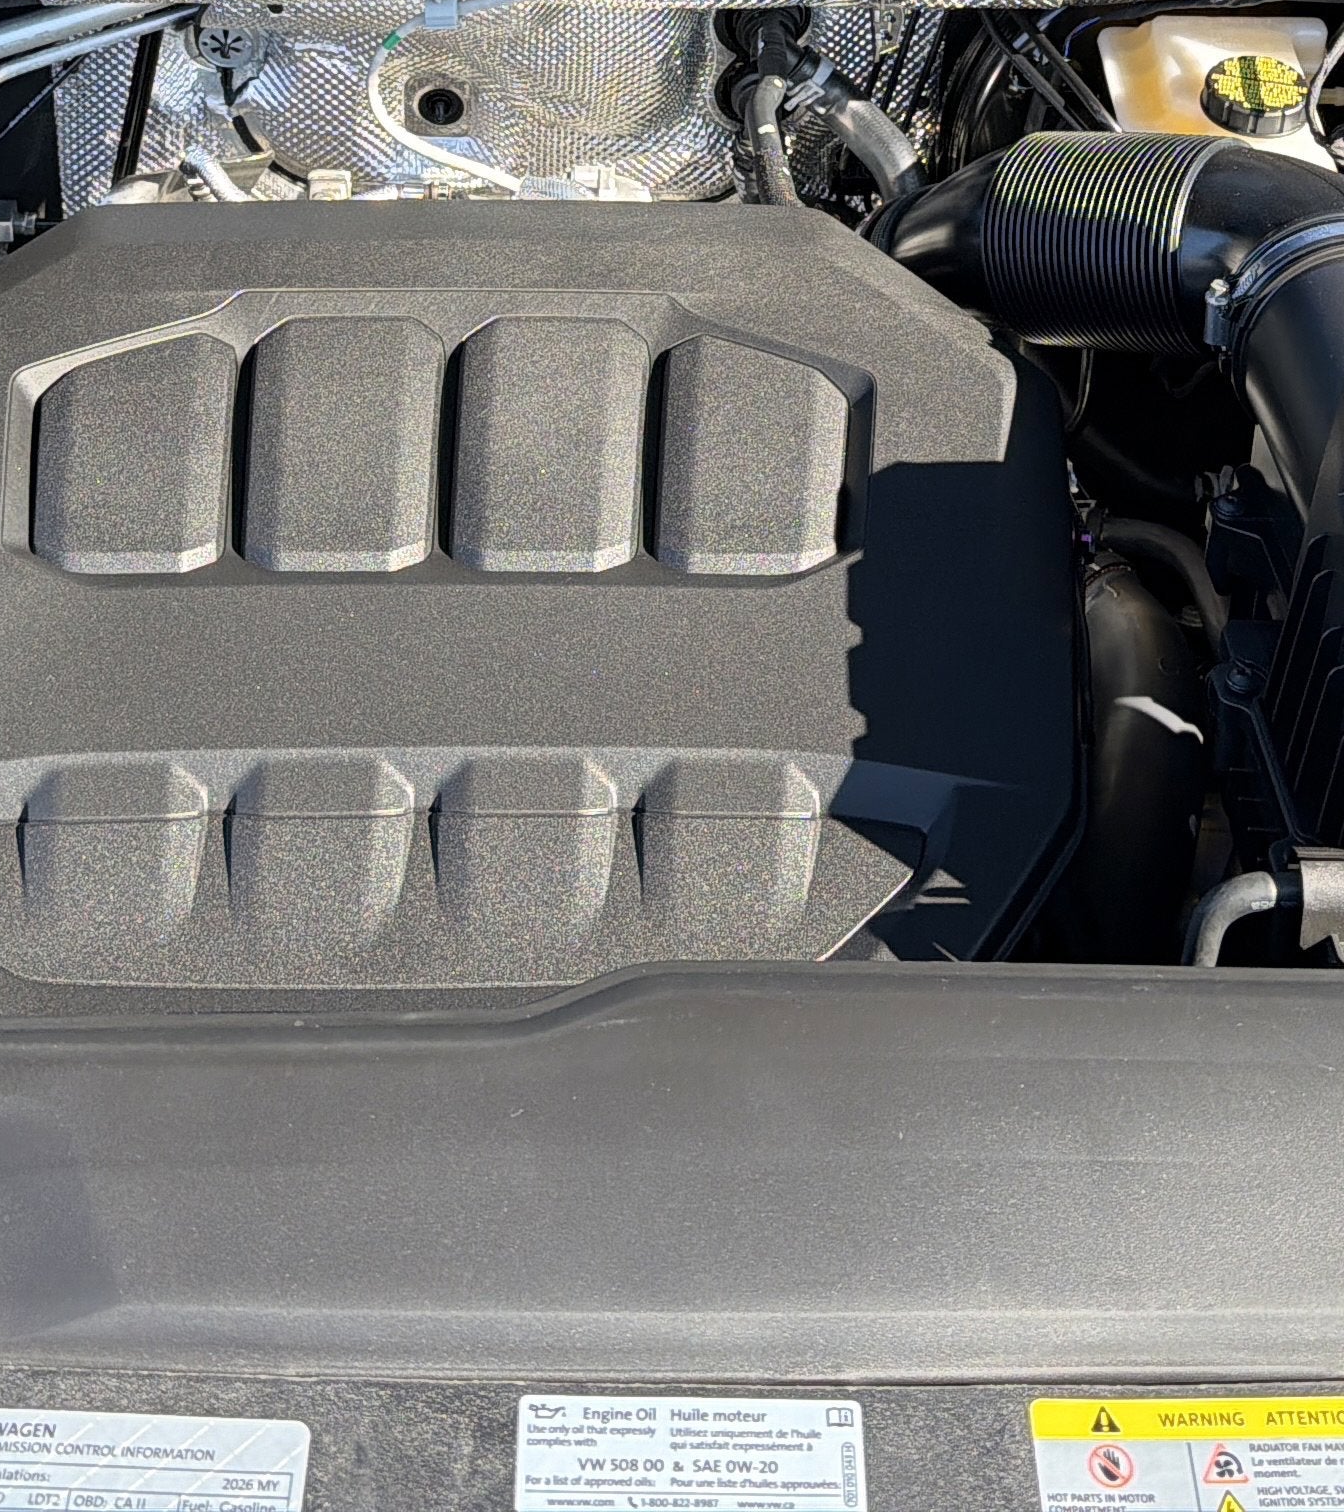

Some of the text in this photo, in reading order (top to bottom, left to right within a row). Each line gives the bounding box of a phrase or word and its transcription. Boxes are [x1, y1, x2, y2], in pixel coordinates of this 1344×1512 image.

[583, 1407, 657, 1424] Engine Oil
[670, 1408, 767, 1423] Huile moteur
[1158, 1411, 1245, 1428] WARNING
[527, 1424, 656, 1438] Use only oil that expressly
[670, 1427, 822, 1440] Utilisez uniquement de l'huile
[527, 1437, 597, 1448] complies with
[670, 1441, 813, 1453] qui satisfait expressément à
[1249, 1442, 1300, 1452] RADIATOR
[1302, 1442, 1322, 1452] FAN
[55, 1442, 117, 1457] CONTROL
[120, 1445, 216, 1461] INFORMATION
[577, 1458, 779, 1474] VW 508 00 & SAE 0W-20
[1251, 1457, 1264, 1466] Le
[1266, 1456, 1322, 1466] ventilateur
[1324, 1456, 1337, 1466] de
[1254, 1469, 1302, 1478] moment.
[222, 1478, 280, 1492] 2026 MY
[525, 1475, 657, 1488] For a list of approved oils:
[670, 1477, 694, 1488] Pour
[696, 1479, 715, 1488] une
[717, 1477, 738, 1488] liste
[740, 1478, 778, 1489] d'huiles
[1257, 1485, 1283, 1495] HIGH
[1286, 1485, 1332, 1496] VOLTAGE,
[27, 1492, 61, 1506] LDT2
[73, 1495, 107, 1508] OBD:
[114, 1496, 135, 1509] CA
[547, 1498, 615, 1506] www.vw.com
[1047, 1493, 1156, 1503] HOT PARTS IN MOTOR
[1258, 1497, 1306, 1507] IGNITION
[181, 1500, 276, 1512] Fuel: Gasoline
[1048, 1504, 1127, 1512] COMPARTMENT
